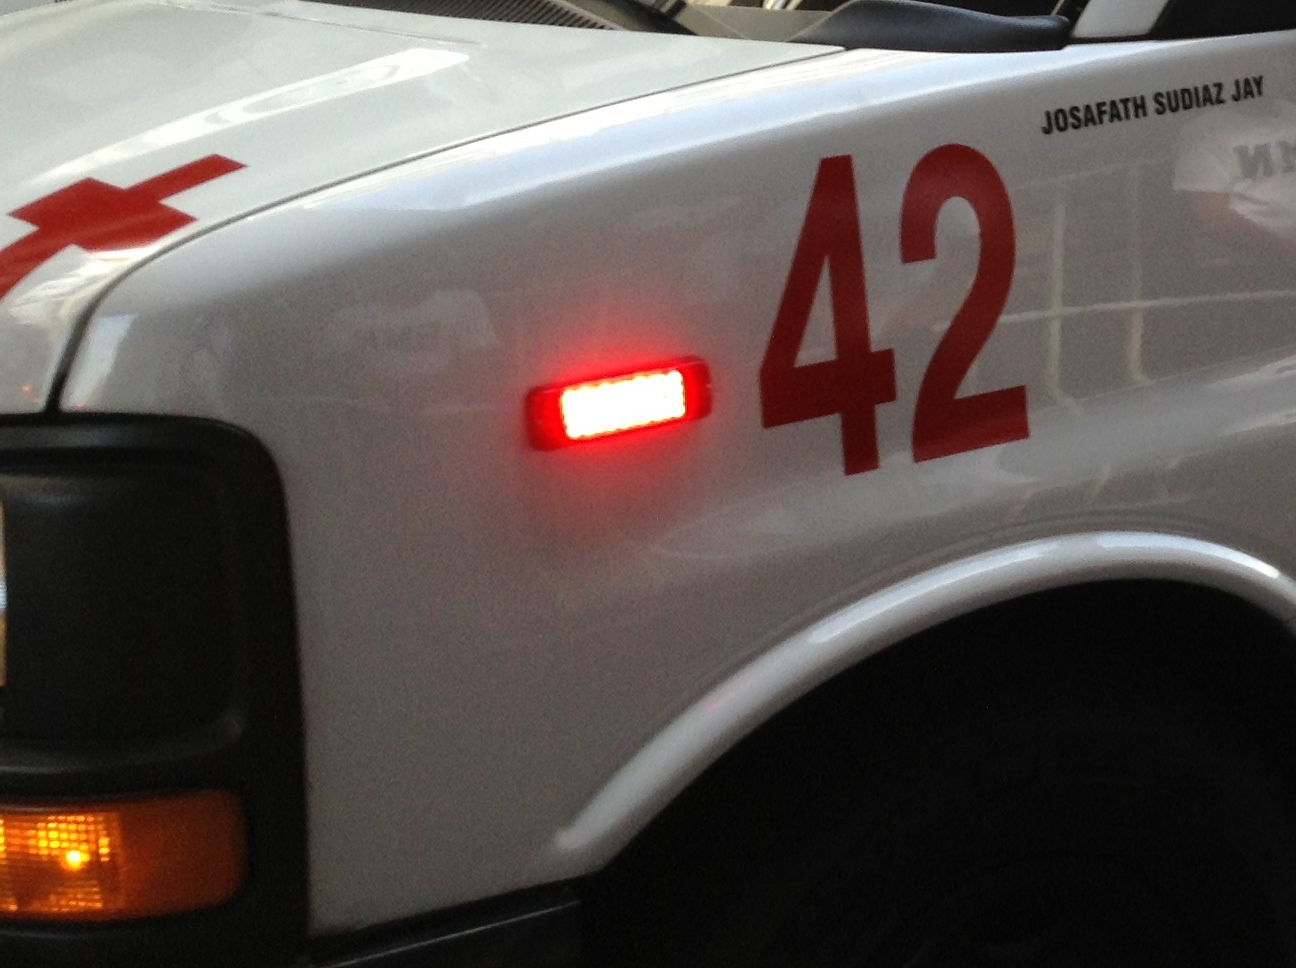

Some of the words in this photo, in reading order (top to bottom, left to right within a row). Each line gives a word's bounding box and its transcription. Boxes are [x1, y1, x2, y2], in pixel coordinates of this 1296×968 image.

[1041, 95, 1148, 135] JOSAFATH
[1153, 82, 1226, 115] SUDIAZ
[1231, 75, 1264, 102] JAY
[760, 143, 1030, 476] 42
